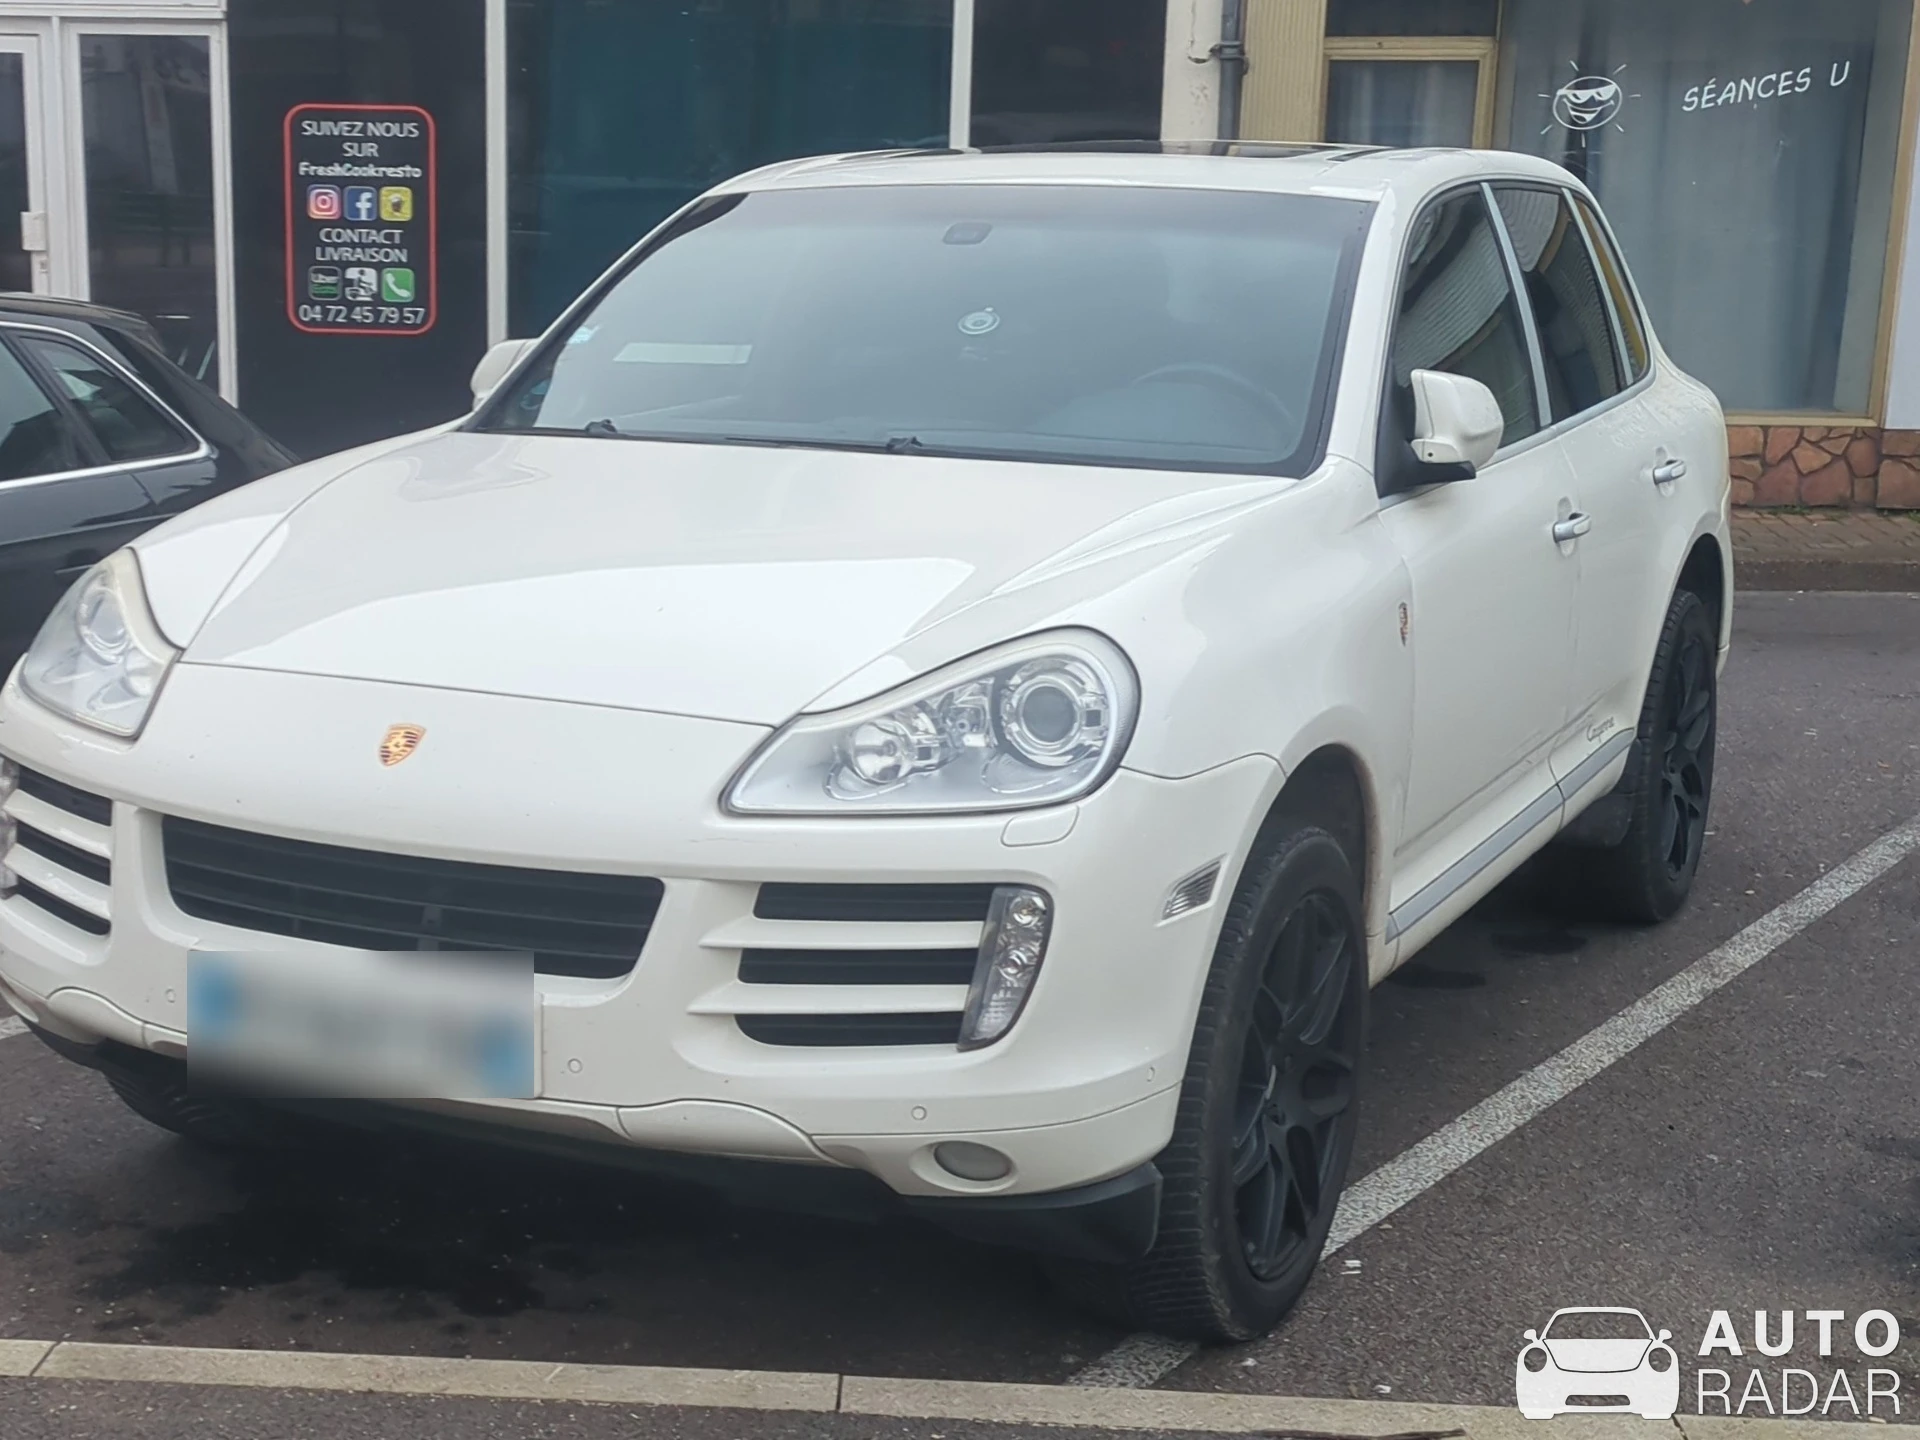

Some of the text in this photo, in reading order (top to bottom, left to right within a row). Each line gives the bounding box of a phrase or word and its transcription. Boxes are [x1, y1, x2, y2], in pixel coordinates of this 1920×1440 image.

[1682, 60, 1850, 112] SÉANCES U
[301, 120, 419, 138] SUIVEZ NOUS
[342, 142, 379, 157] SUR
[319, 228, 404, 244] CONTACT
[315, 246, 408, 263] LIVRAISON
[299, 304, 425, 324] 04 72 45 79 57
